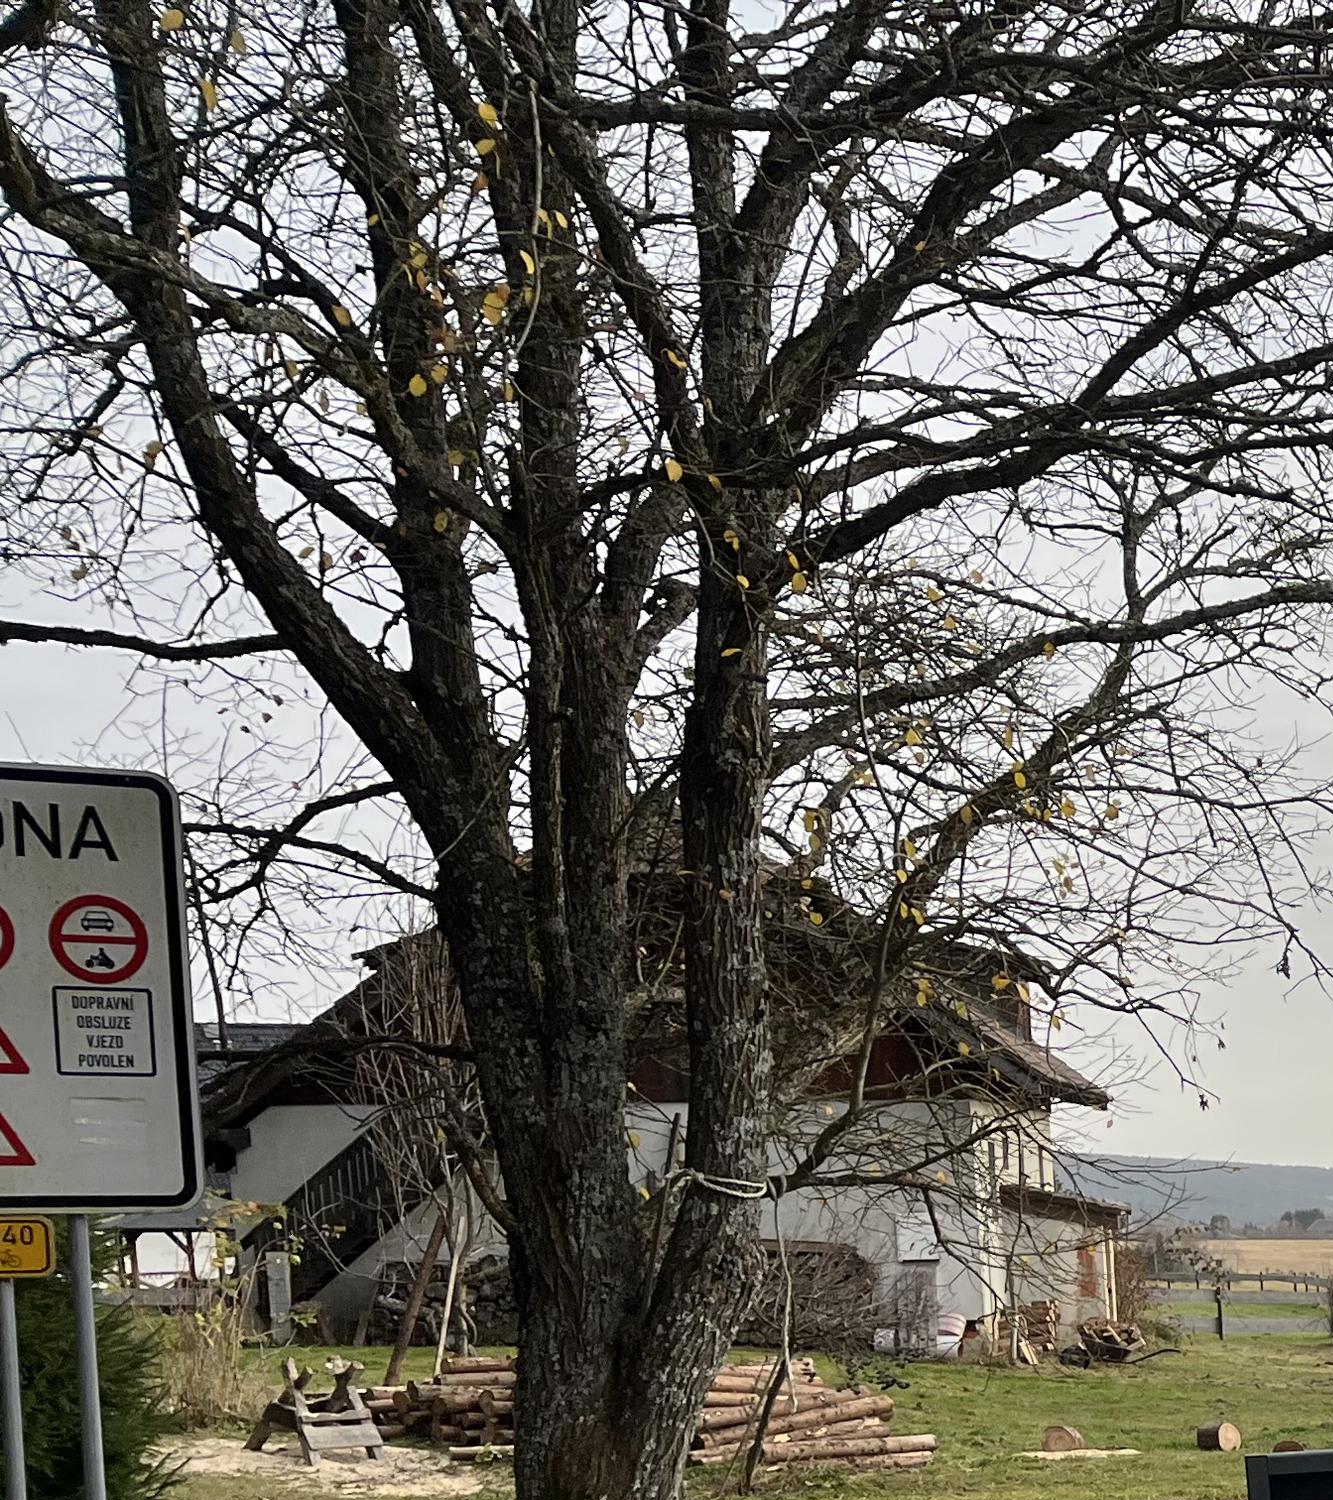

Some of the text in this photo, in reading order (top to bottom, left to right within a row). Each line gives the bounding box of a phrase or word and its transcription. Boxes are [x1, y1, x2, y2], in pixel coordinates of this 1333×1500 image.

[0, 801, 119, 861] NA
[71, 994, 134, 1011] DOPRAVNÍ
[76, 1015, 132, 1030] OBSLUZE
[86, 1034, 124, 1049] VJEZD
[78, 1054, 135, 1068] POVOLEN
